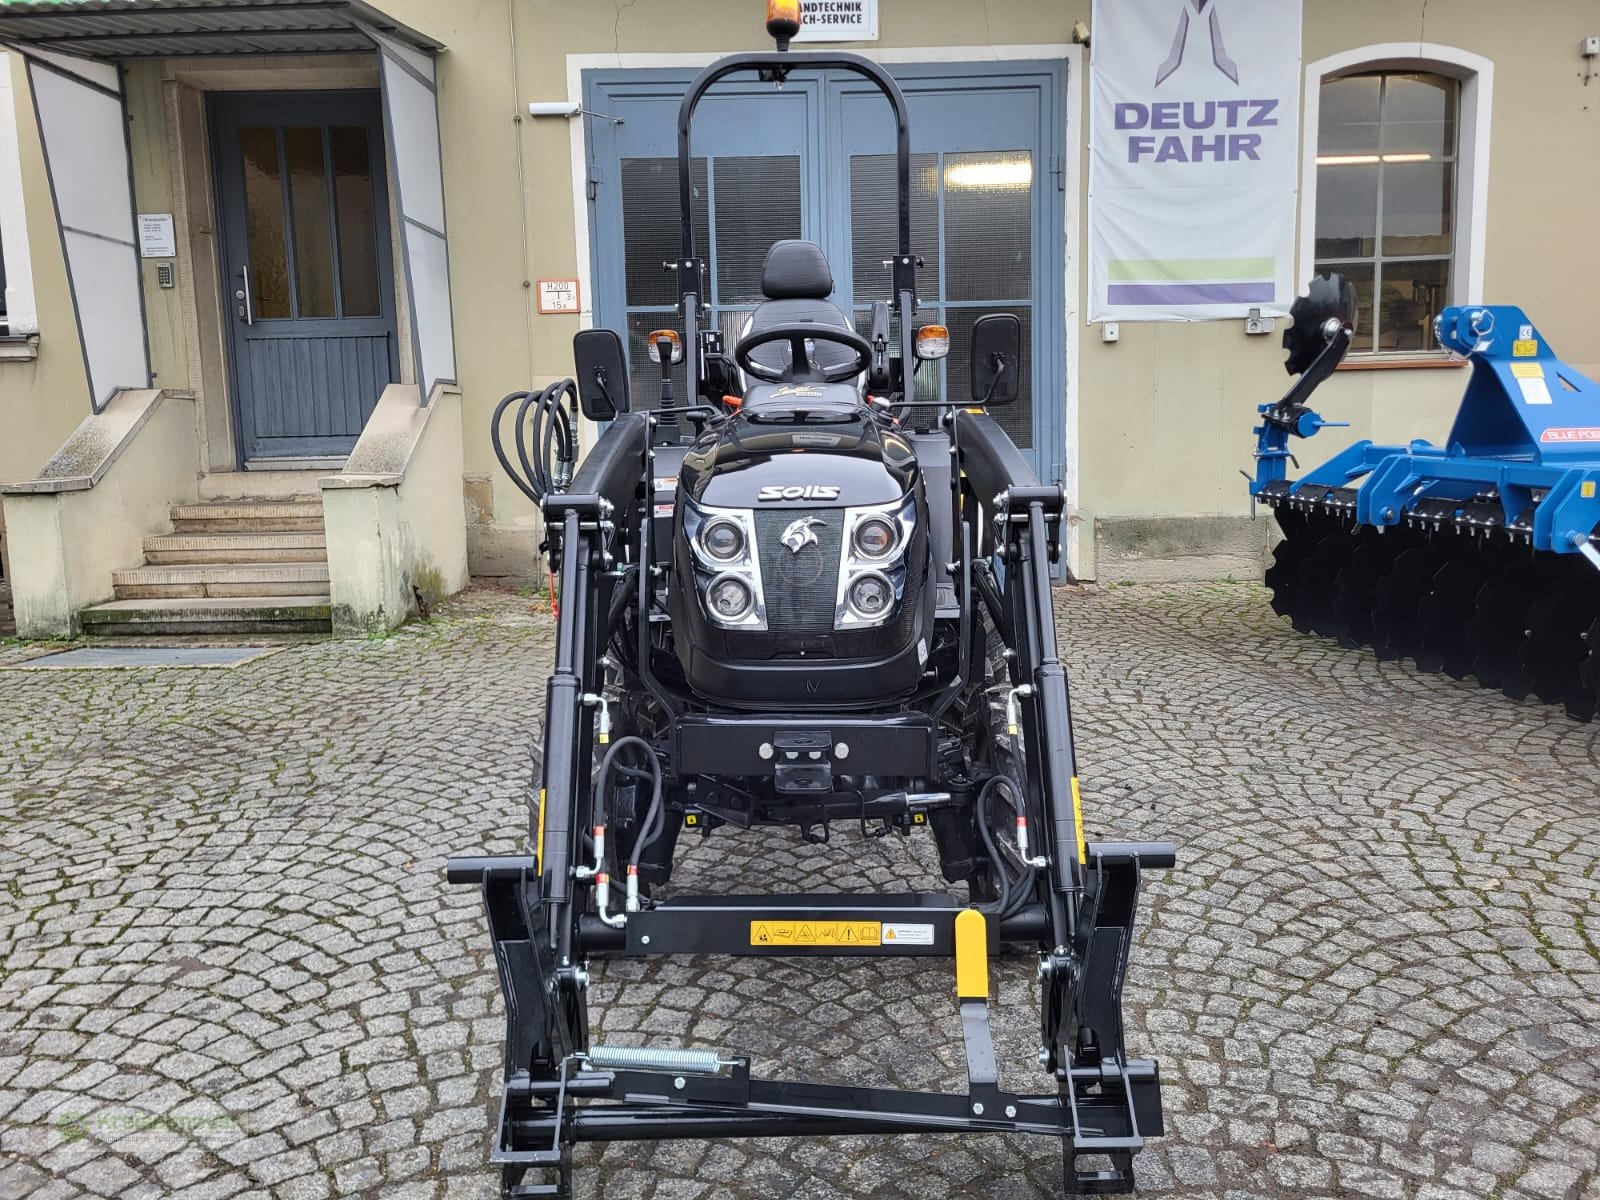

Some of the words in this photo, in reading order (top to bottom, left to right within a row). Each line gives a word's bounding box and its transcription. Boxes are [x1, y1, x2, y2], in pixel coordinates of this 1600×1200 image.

[800, 14, 862, 24] CH-SERVICE
[1114, 99, 1279, 130] DEUTZ
[1128, 134, 1262, 163] FAHR
[757, 486, 841, 500] SOLIS
